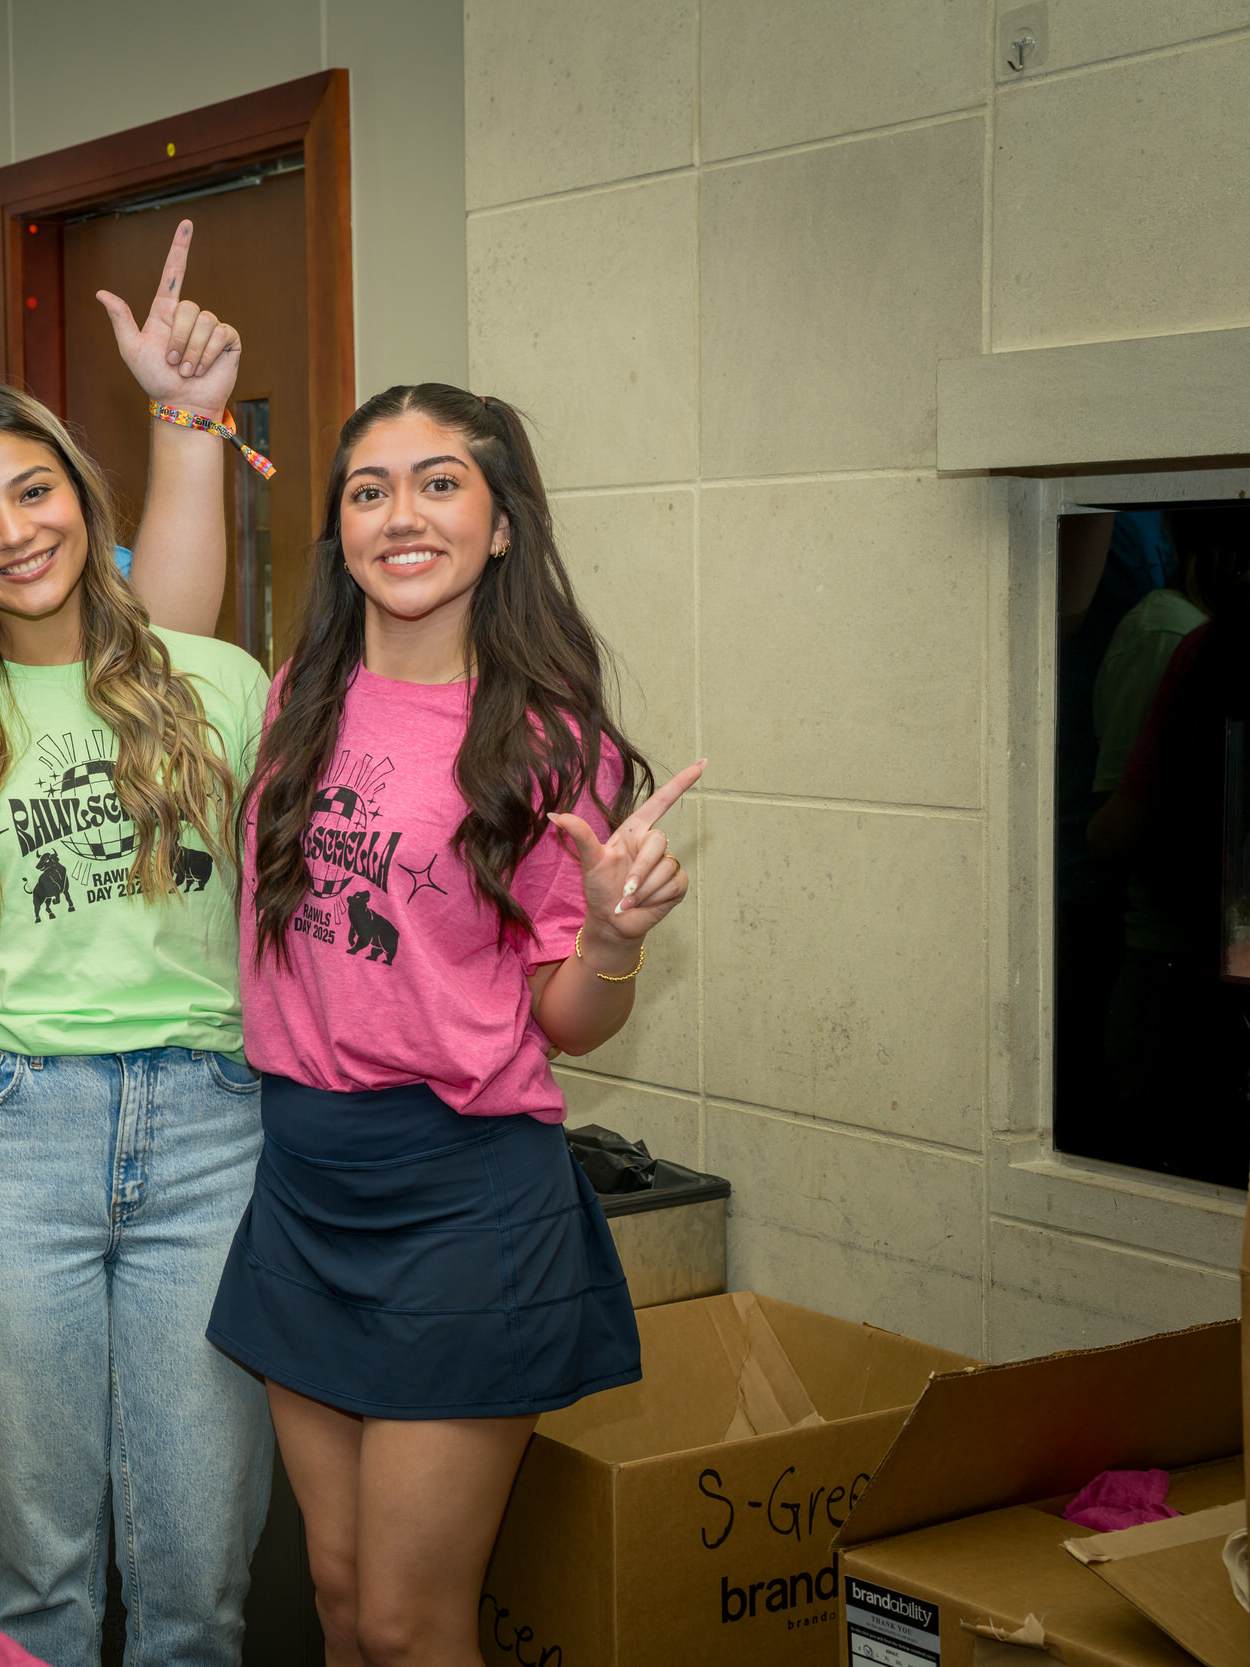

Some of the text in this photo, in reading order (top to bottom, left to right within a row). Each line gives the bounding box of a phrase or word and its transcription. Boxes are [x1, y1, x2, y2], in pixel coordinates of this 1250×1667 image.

[8, 792, 132, 857] RAWLSC
[87, 881, 144, 904] DAY 202
[303, 903, 331, 927] RAWLS
[294, 917, 335, 944] DAY 2025
[852, 1581, 932, 1627] brandability
[871, 1616, 896, 1630] THANK
